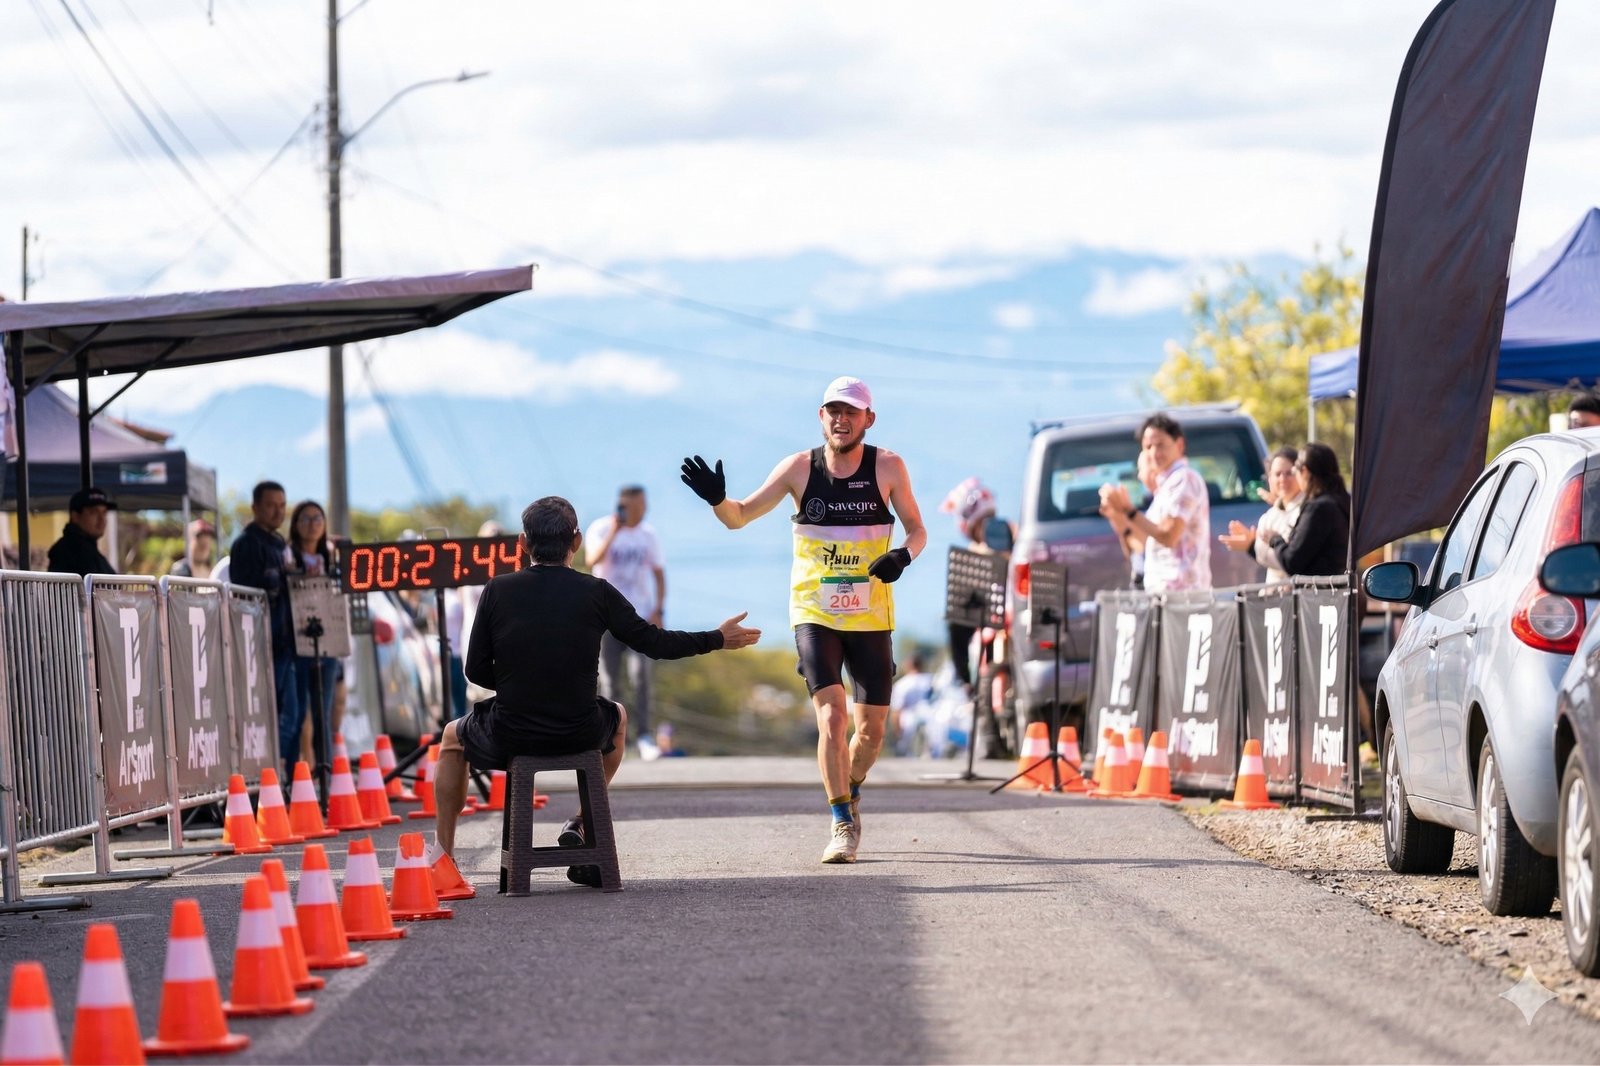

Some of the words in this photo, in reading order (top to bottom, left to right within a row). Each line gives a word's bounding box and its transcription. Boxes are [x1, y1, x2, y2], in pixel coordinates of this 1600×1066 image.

[828, 501, 878, 514] savegre
[830, 594, 860, 608] 204
[119, 736, 155, 794] ArSport
[187, 724, 221, 778] ArSport
